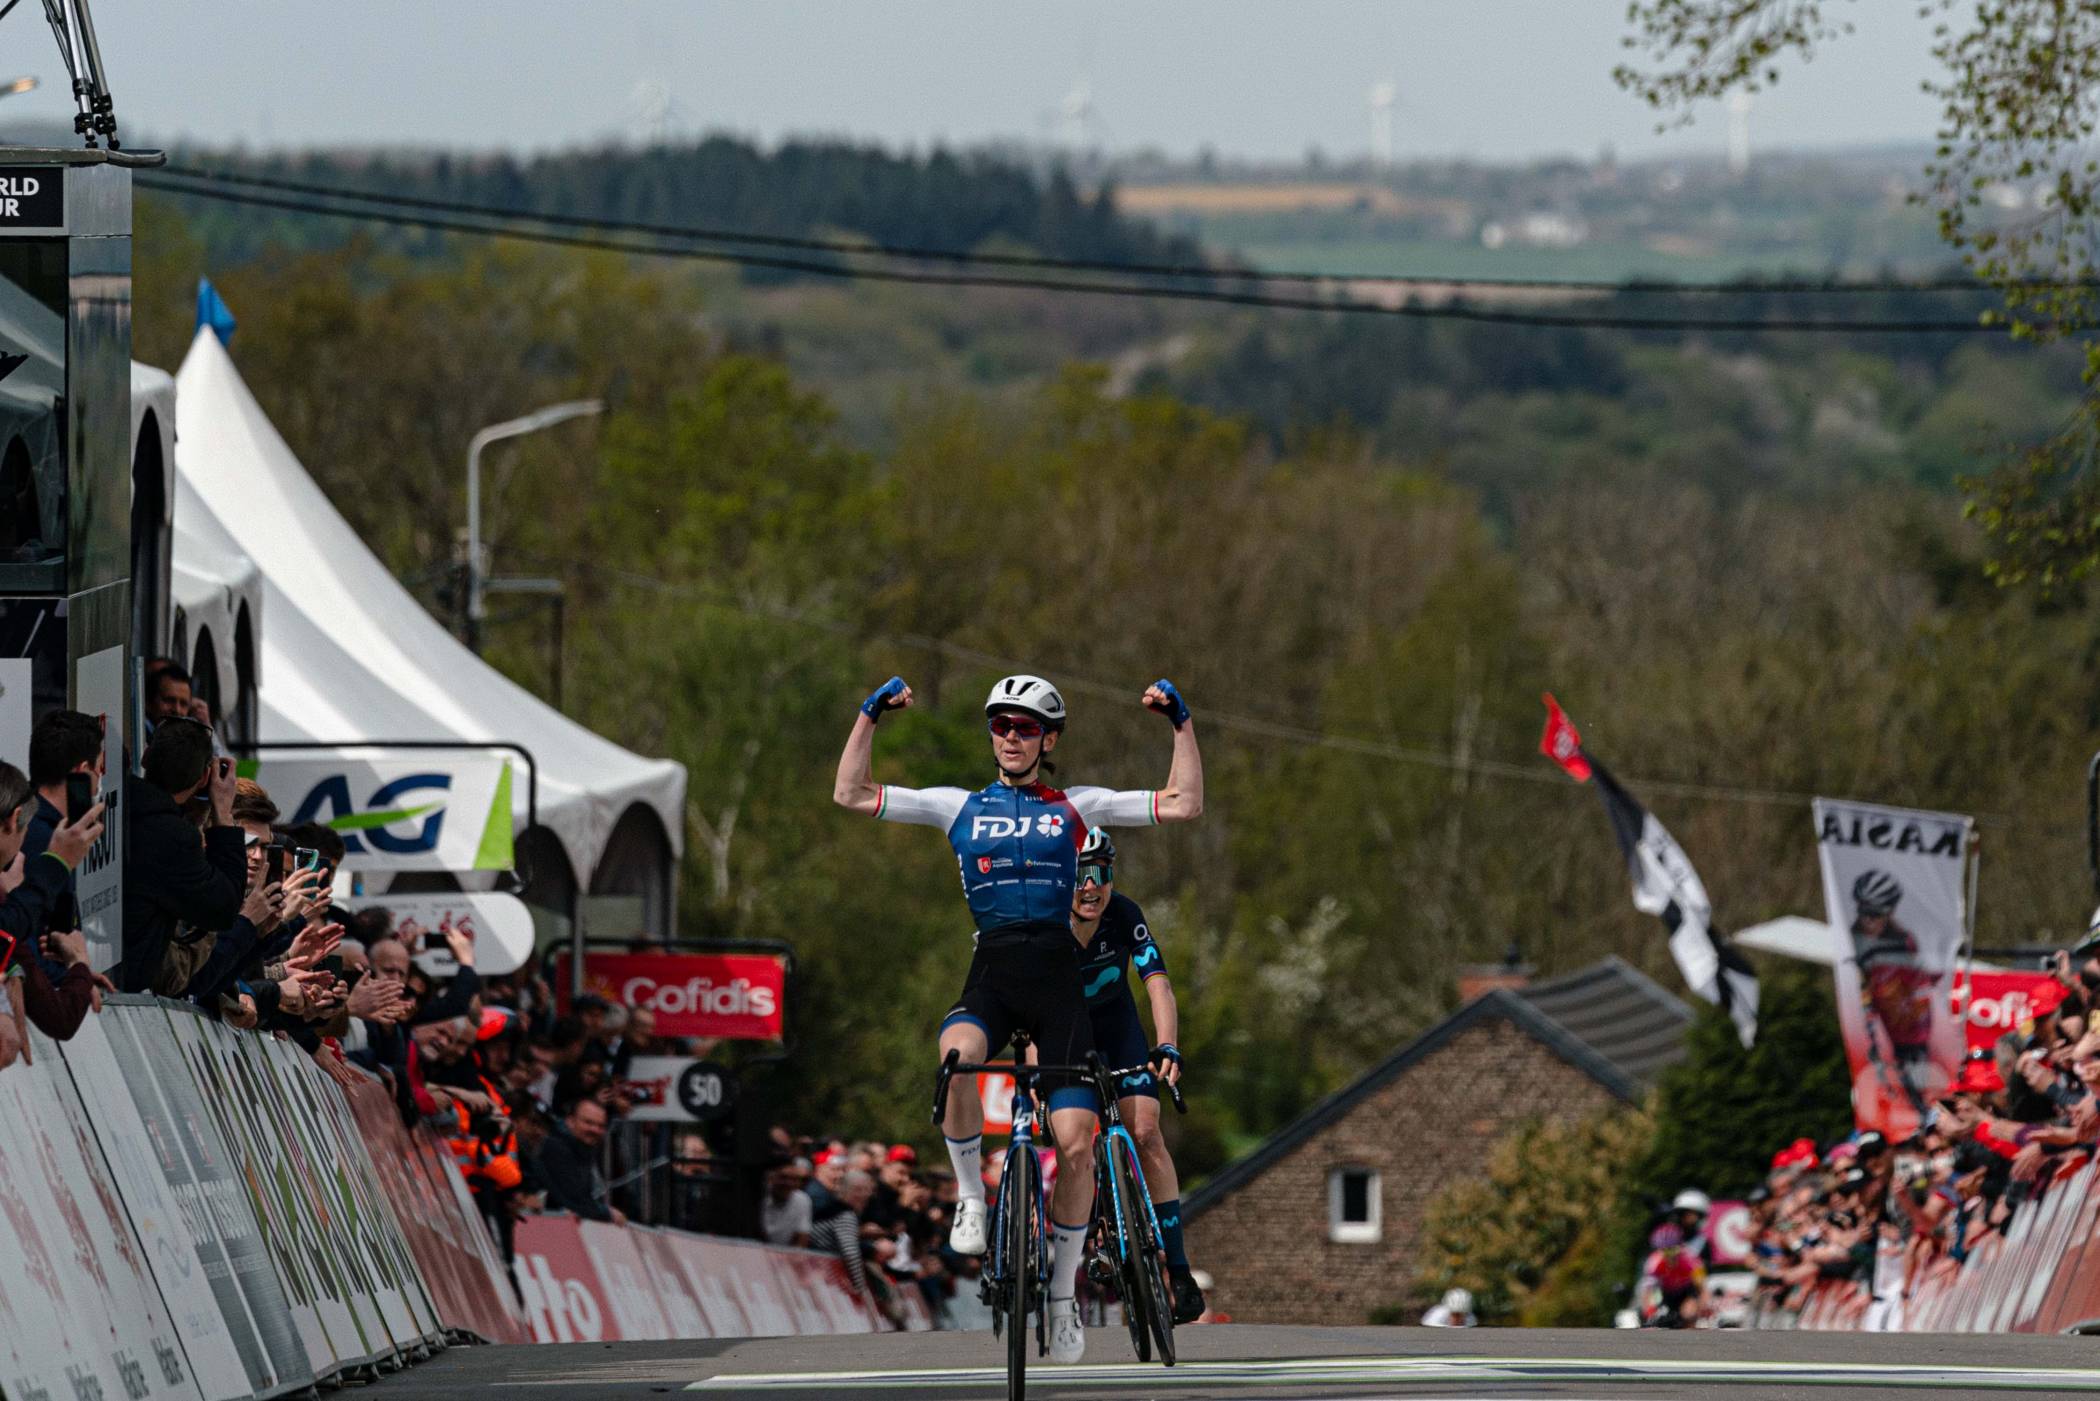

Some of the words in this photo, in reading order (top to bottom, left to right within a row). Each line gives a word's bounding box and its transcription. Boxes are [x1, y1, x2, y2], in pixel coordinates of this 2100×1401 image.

[291, 773, 452, 855] AG
[972, 815, 1032, 841] FDJ
[622, 976, 776, 1017] Cofidis
[688, 1073, 722, 1106] 50
